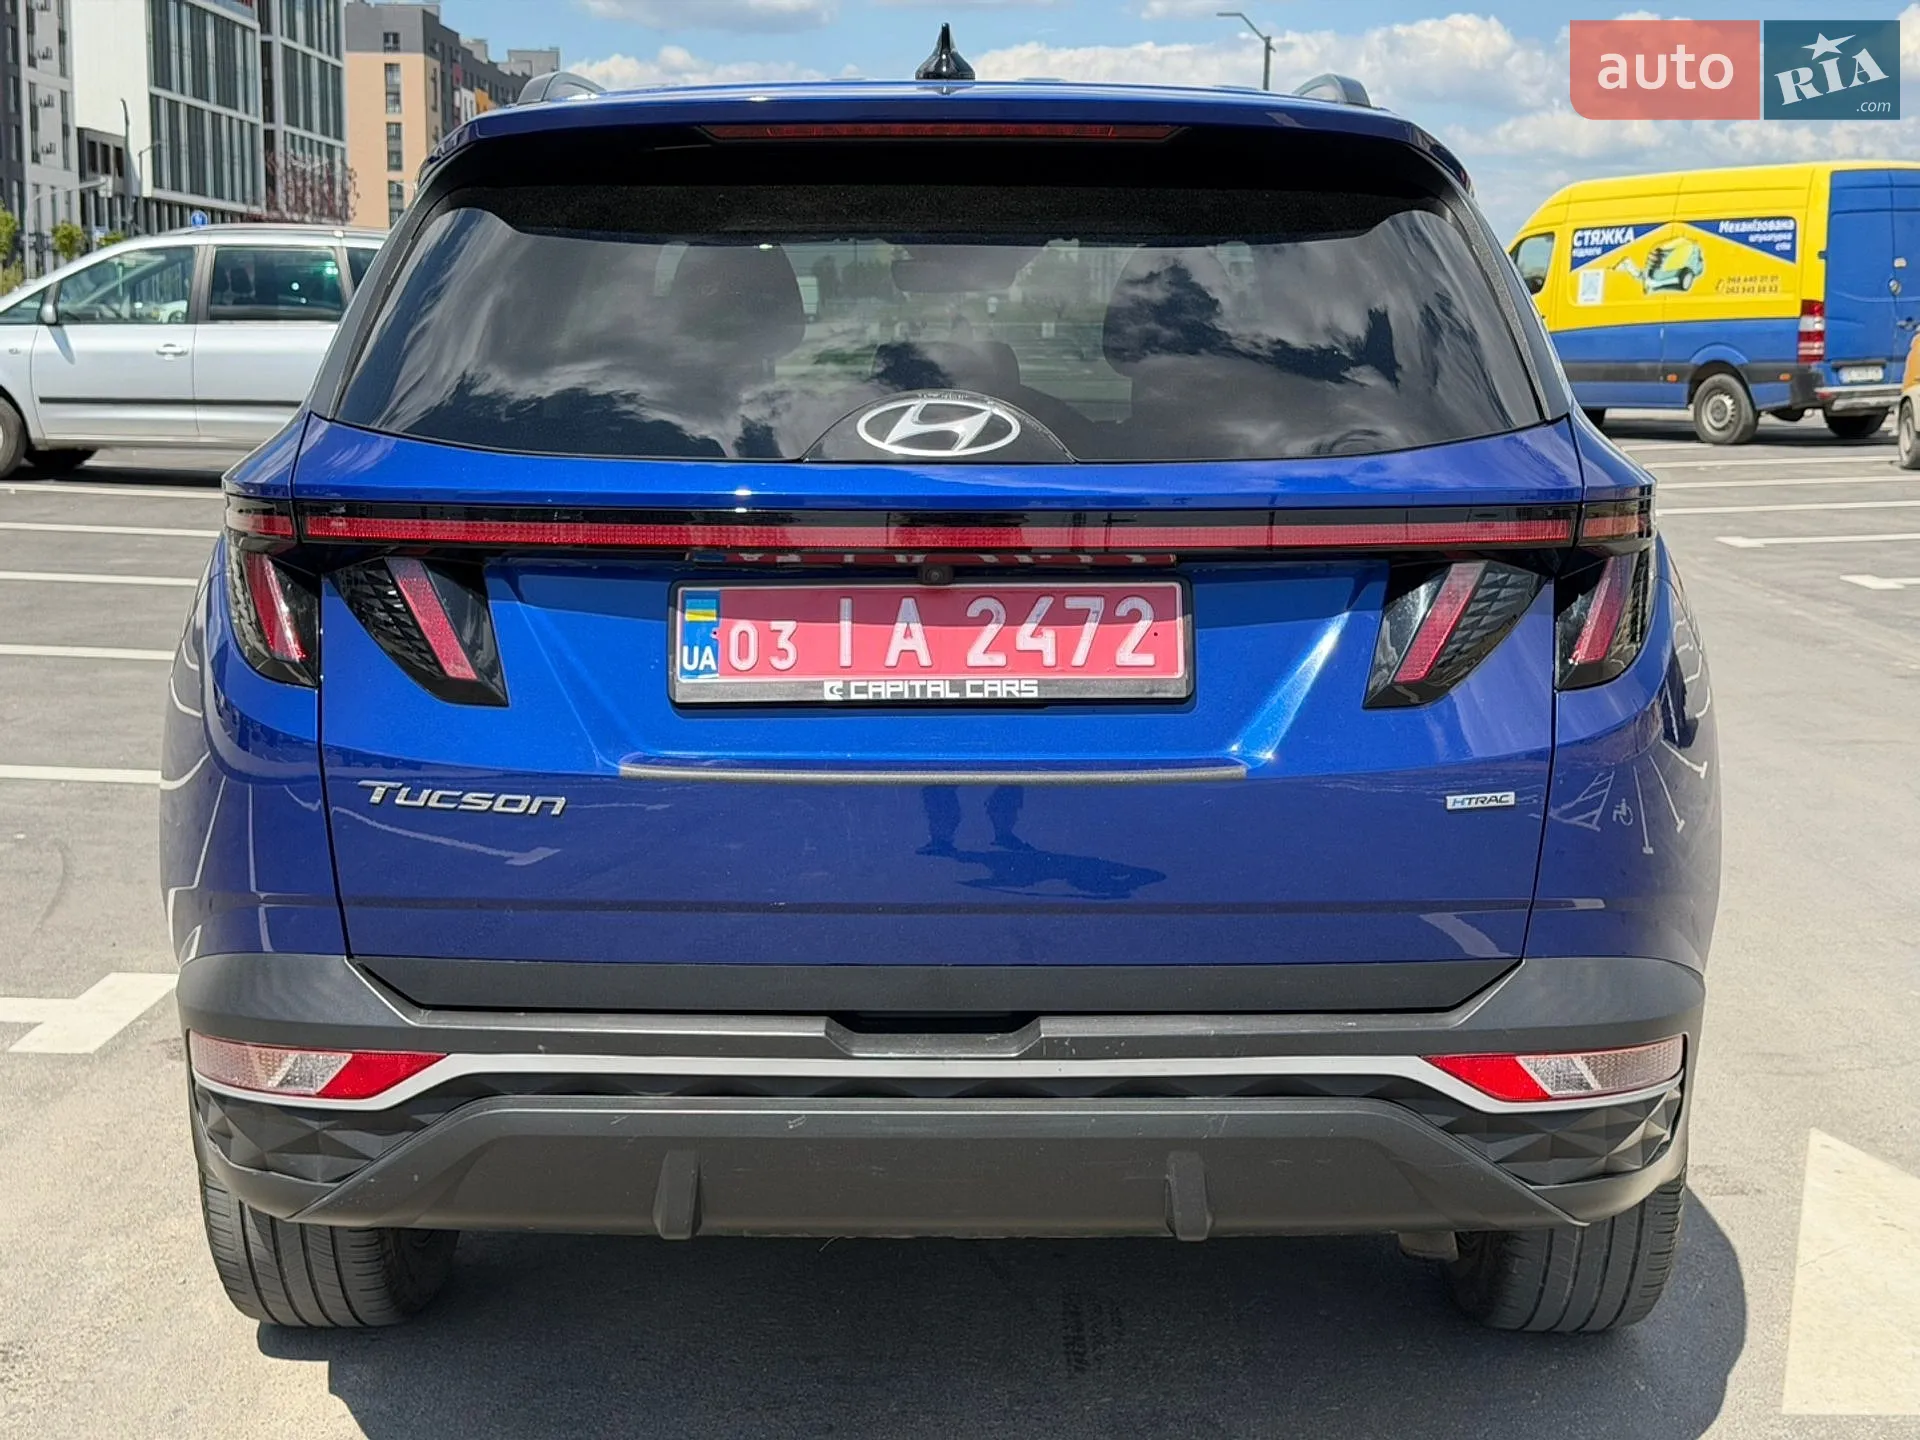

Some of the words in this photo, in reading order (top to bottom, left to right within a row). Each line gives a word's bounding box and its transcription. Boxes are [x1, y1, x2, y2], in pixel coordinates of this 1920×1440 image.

[1573, 227, 1634, 247] СТЯЖКА
[728, 620, 798, 671] 03
[966, 596, 1156, 667] 2472
[682, 645, 717, 671] UA
[850, 680, 960, 700] CAPITAL
[965, 680, 1039, 698] CARS
[1452, 794, 1510, 806] HTRAC
